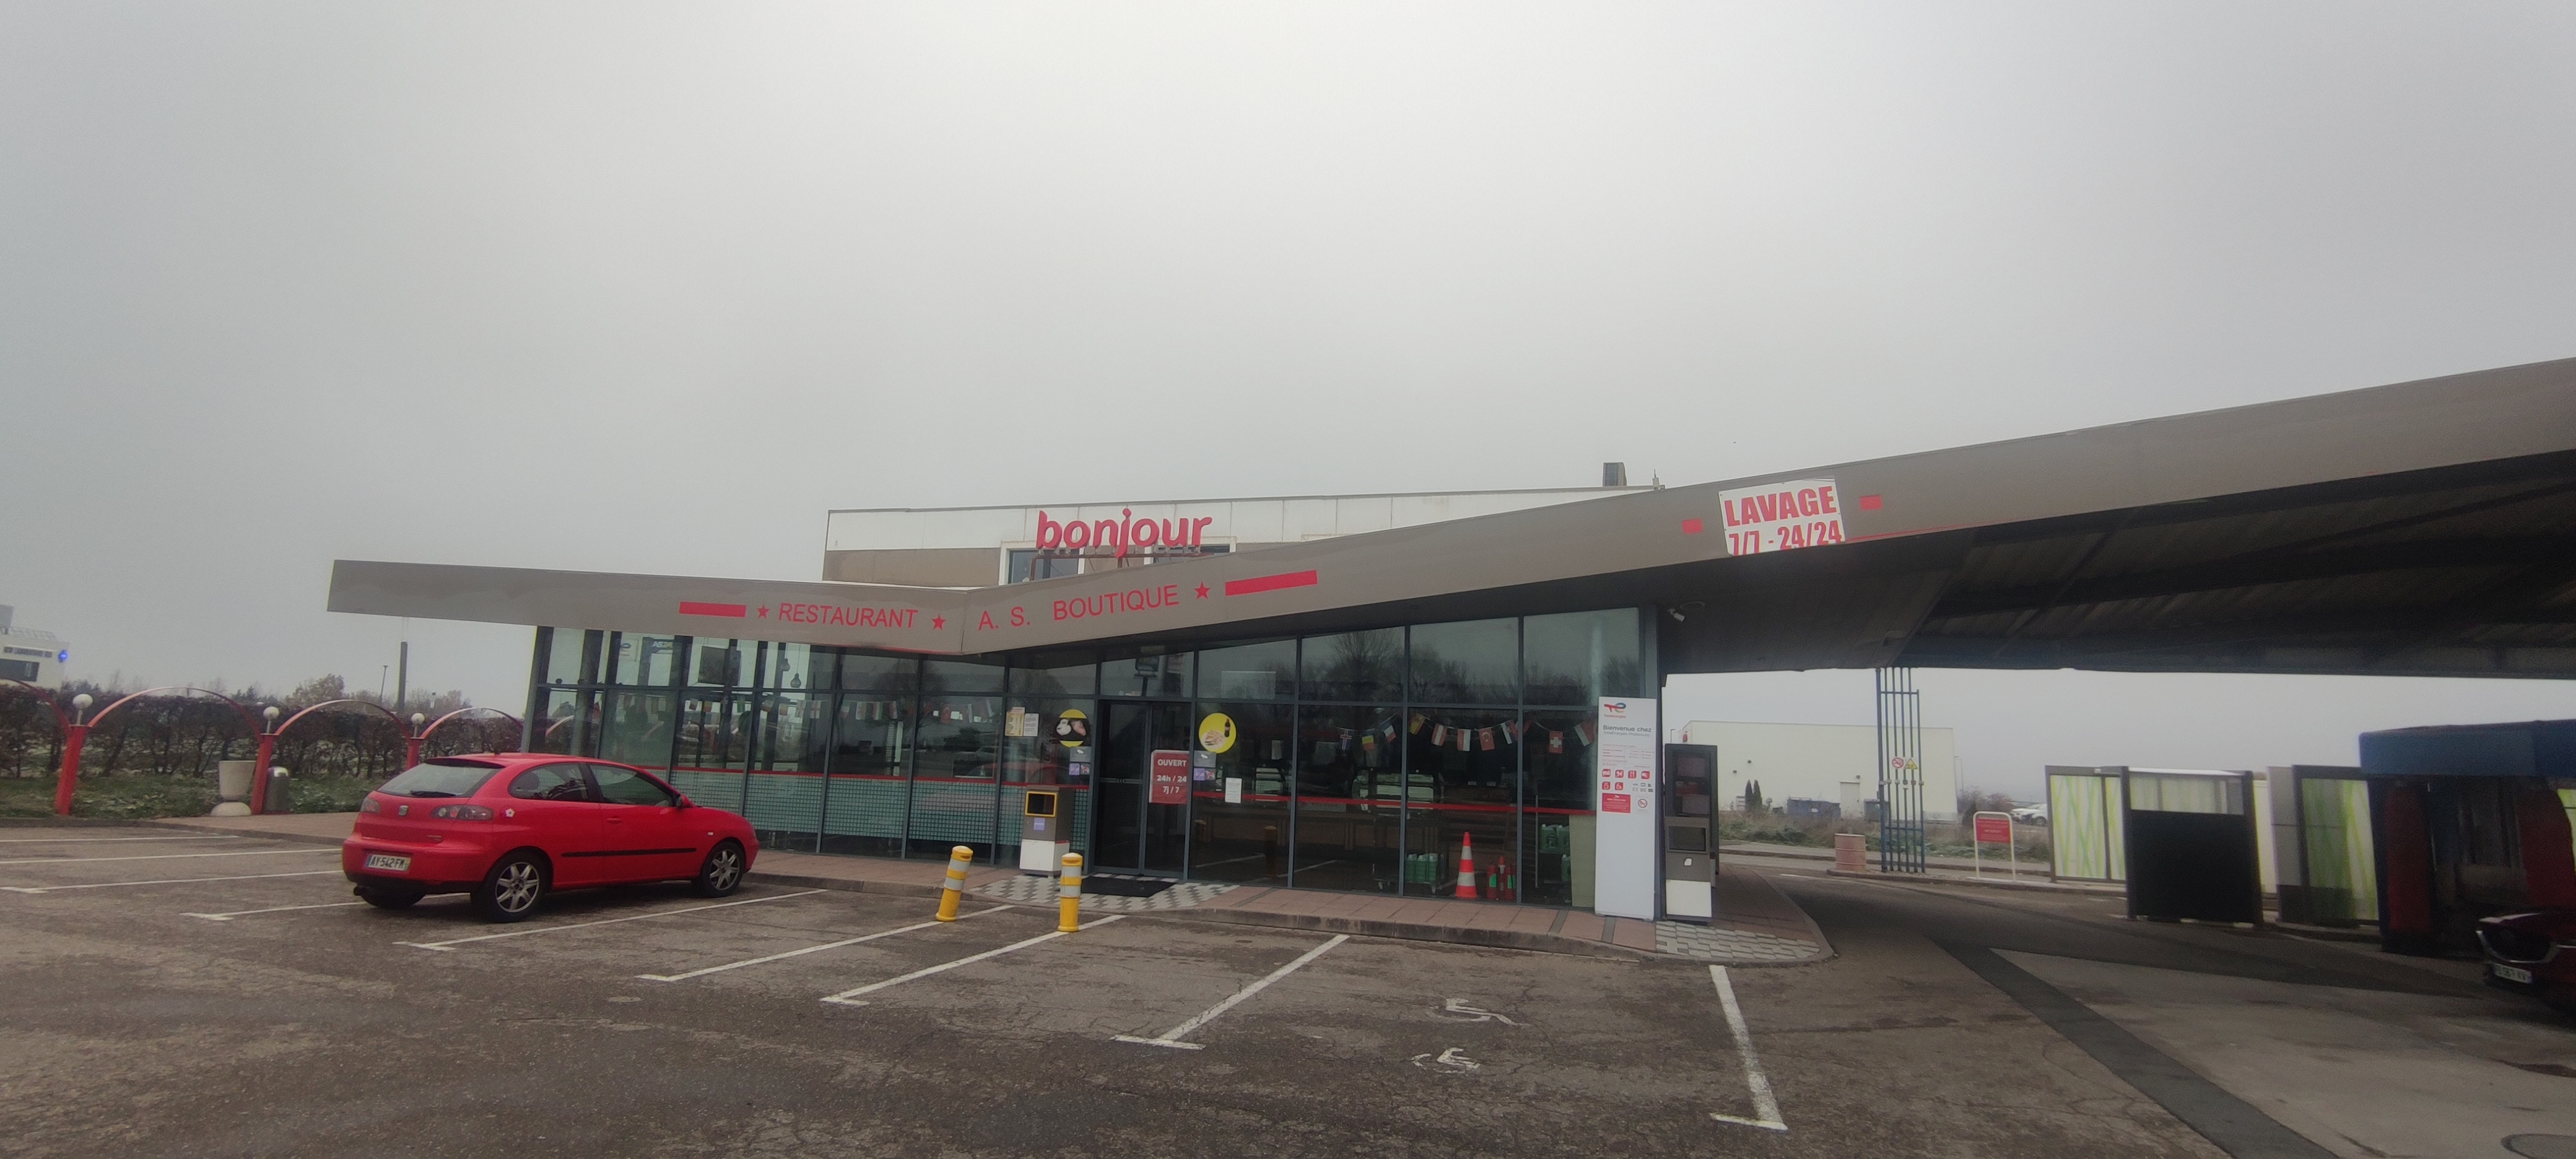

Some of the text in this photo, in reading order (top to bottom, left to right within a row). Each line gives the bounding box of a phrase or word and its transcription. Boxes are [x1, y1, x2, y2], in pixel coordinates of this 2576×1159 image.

[1724, 485, 1837, 527] LAVAGE
[1035, 508, 1213, 558] bonjour
[1729, 530, 1760, 557] 7/7
[1777, 519, 1842, 551] 24/24
[778, 602, 919, 628] RESTAURANT
[978, 584, 1180, 631] A. S. BOUTIQUE
[1162, 786, 1169, 795] 7j
